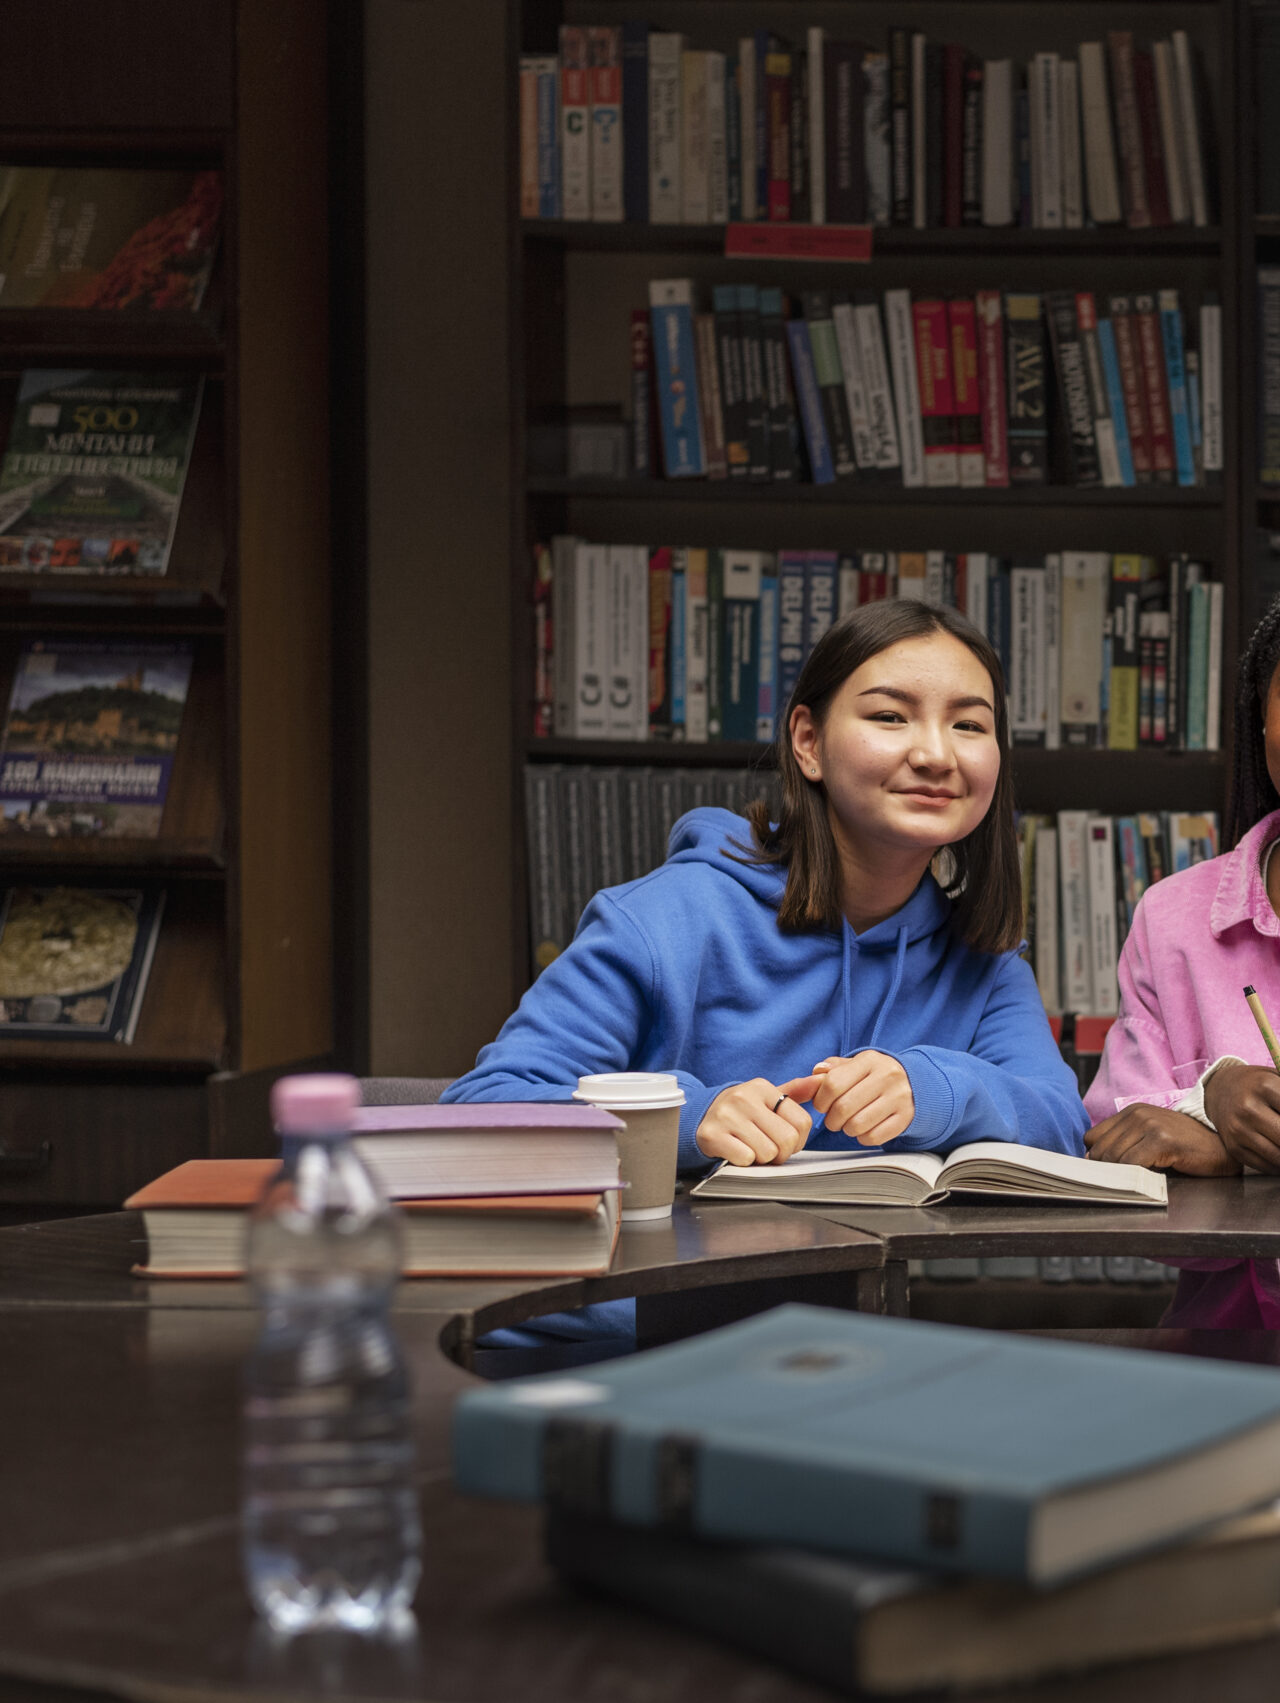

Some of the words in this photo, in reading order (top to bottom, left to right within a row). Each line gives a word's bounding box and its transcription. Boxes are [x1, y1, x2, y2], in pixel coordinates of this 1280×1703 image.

[1059, 341, 1093, 434] PHOTOSHOP
[73, 405, 139, 433] 500
[1016, 399, 1044, 418] 2
[780, 576, 804, 645] DELPHI
[779, 647, 803, 663] 6
[2, 760, 39, 782] 100
